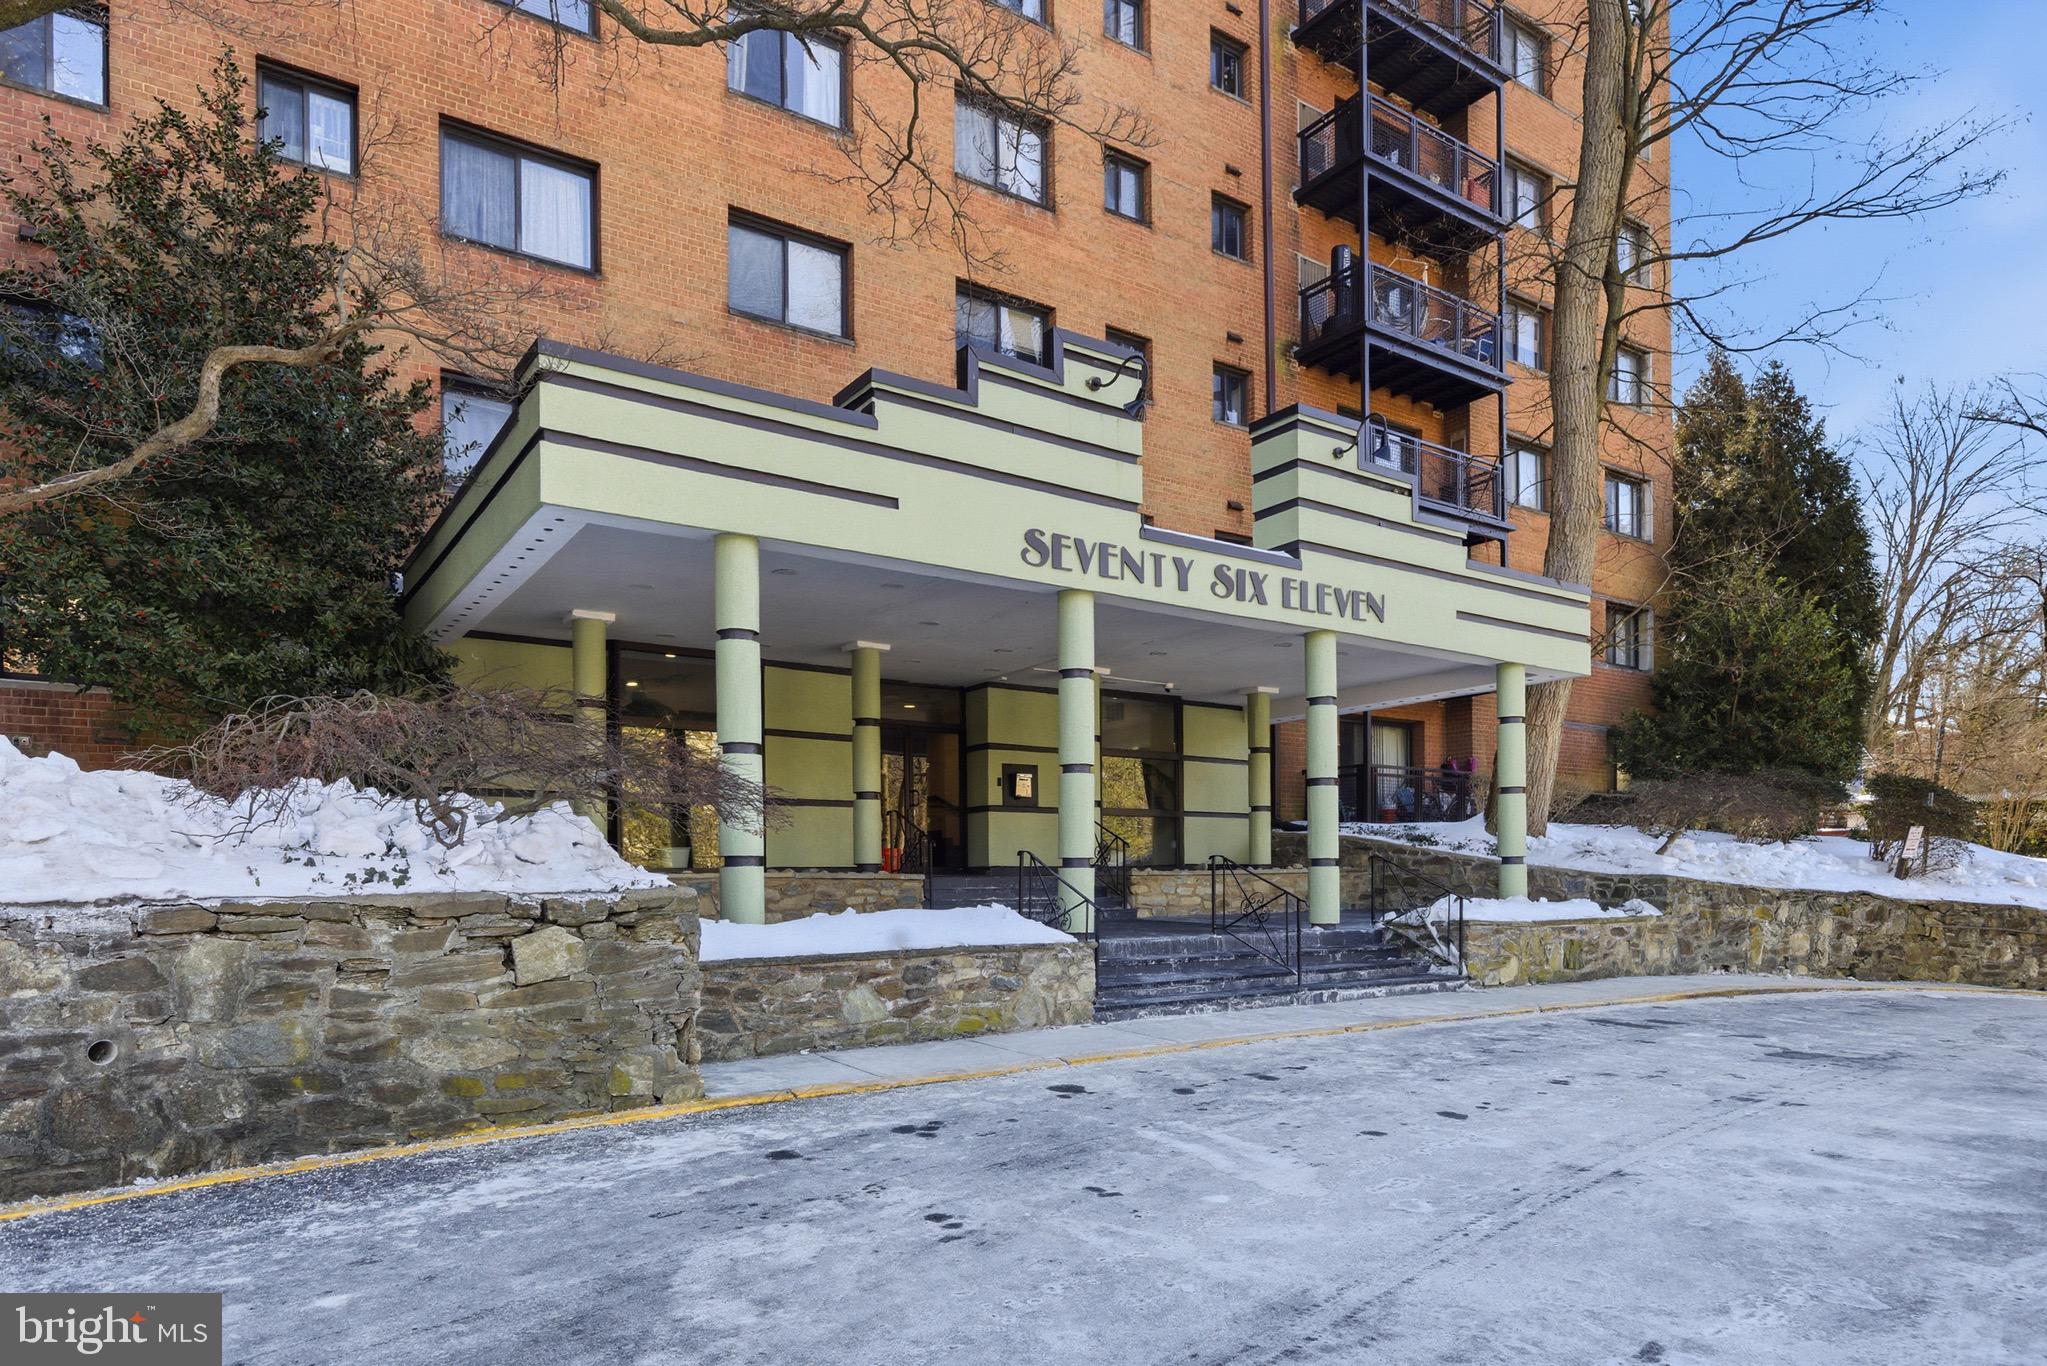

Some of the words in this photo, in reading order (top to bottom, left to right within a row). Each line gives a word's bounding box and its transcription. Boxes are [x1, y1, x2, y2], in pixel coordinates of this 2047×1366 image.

[1020, 528, 1194, 592] SEVENTY
[1210, 563, 1268, 606] SIX
[1281, 576, 1385, 623] ELEVEN
